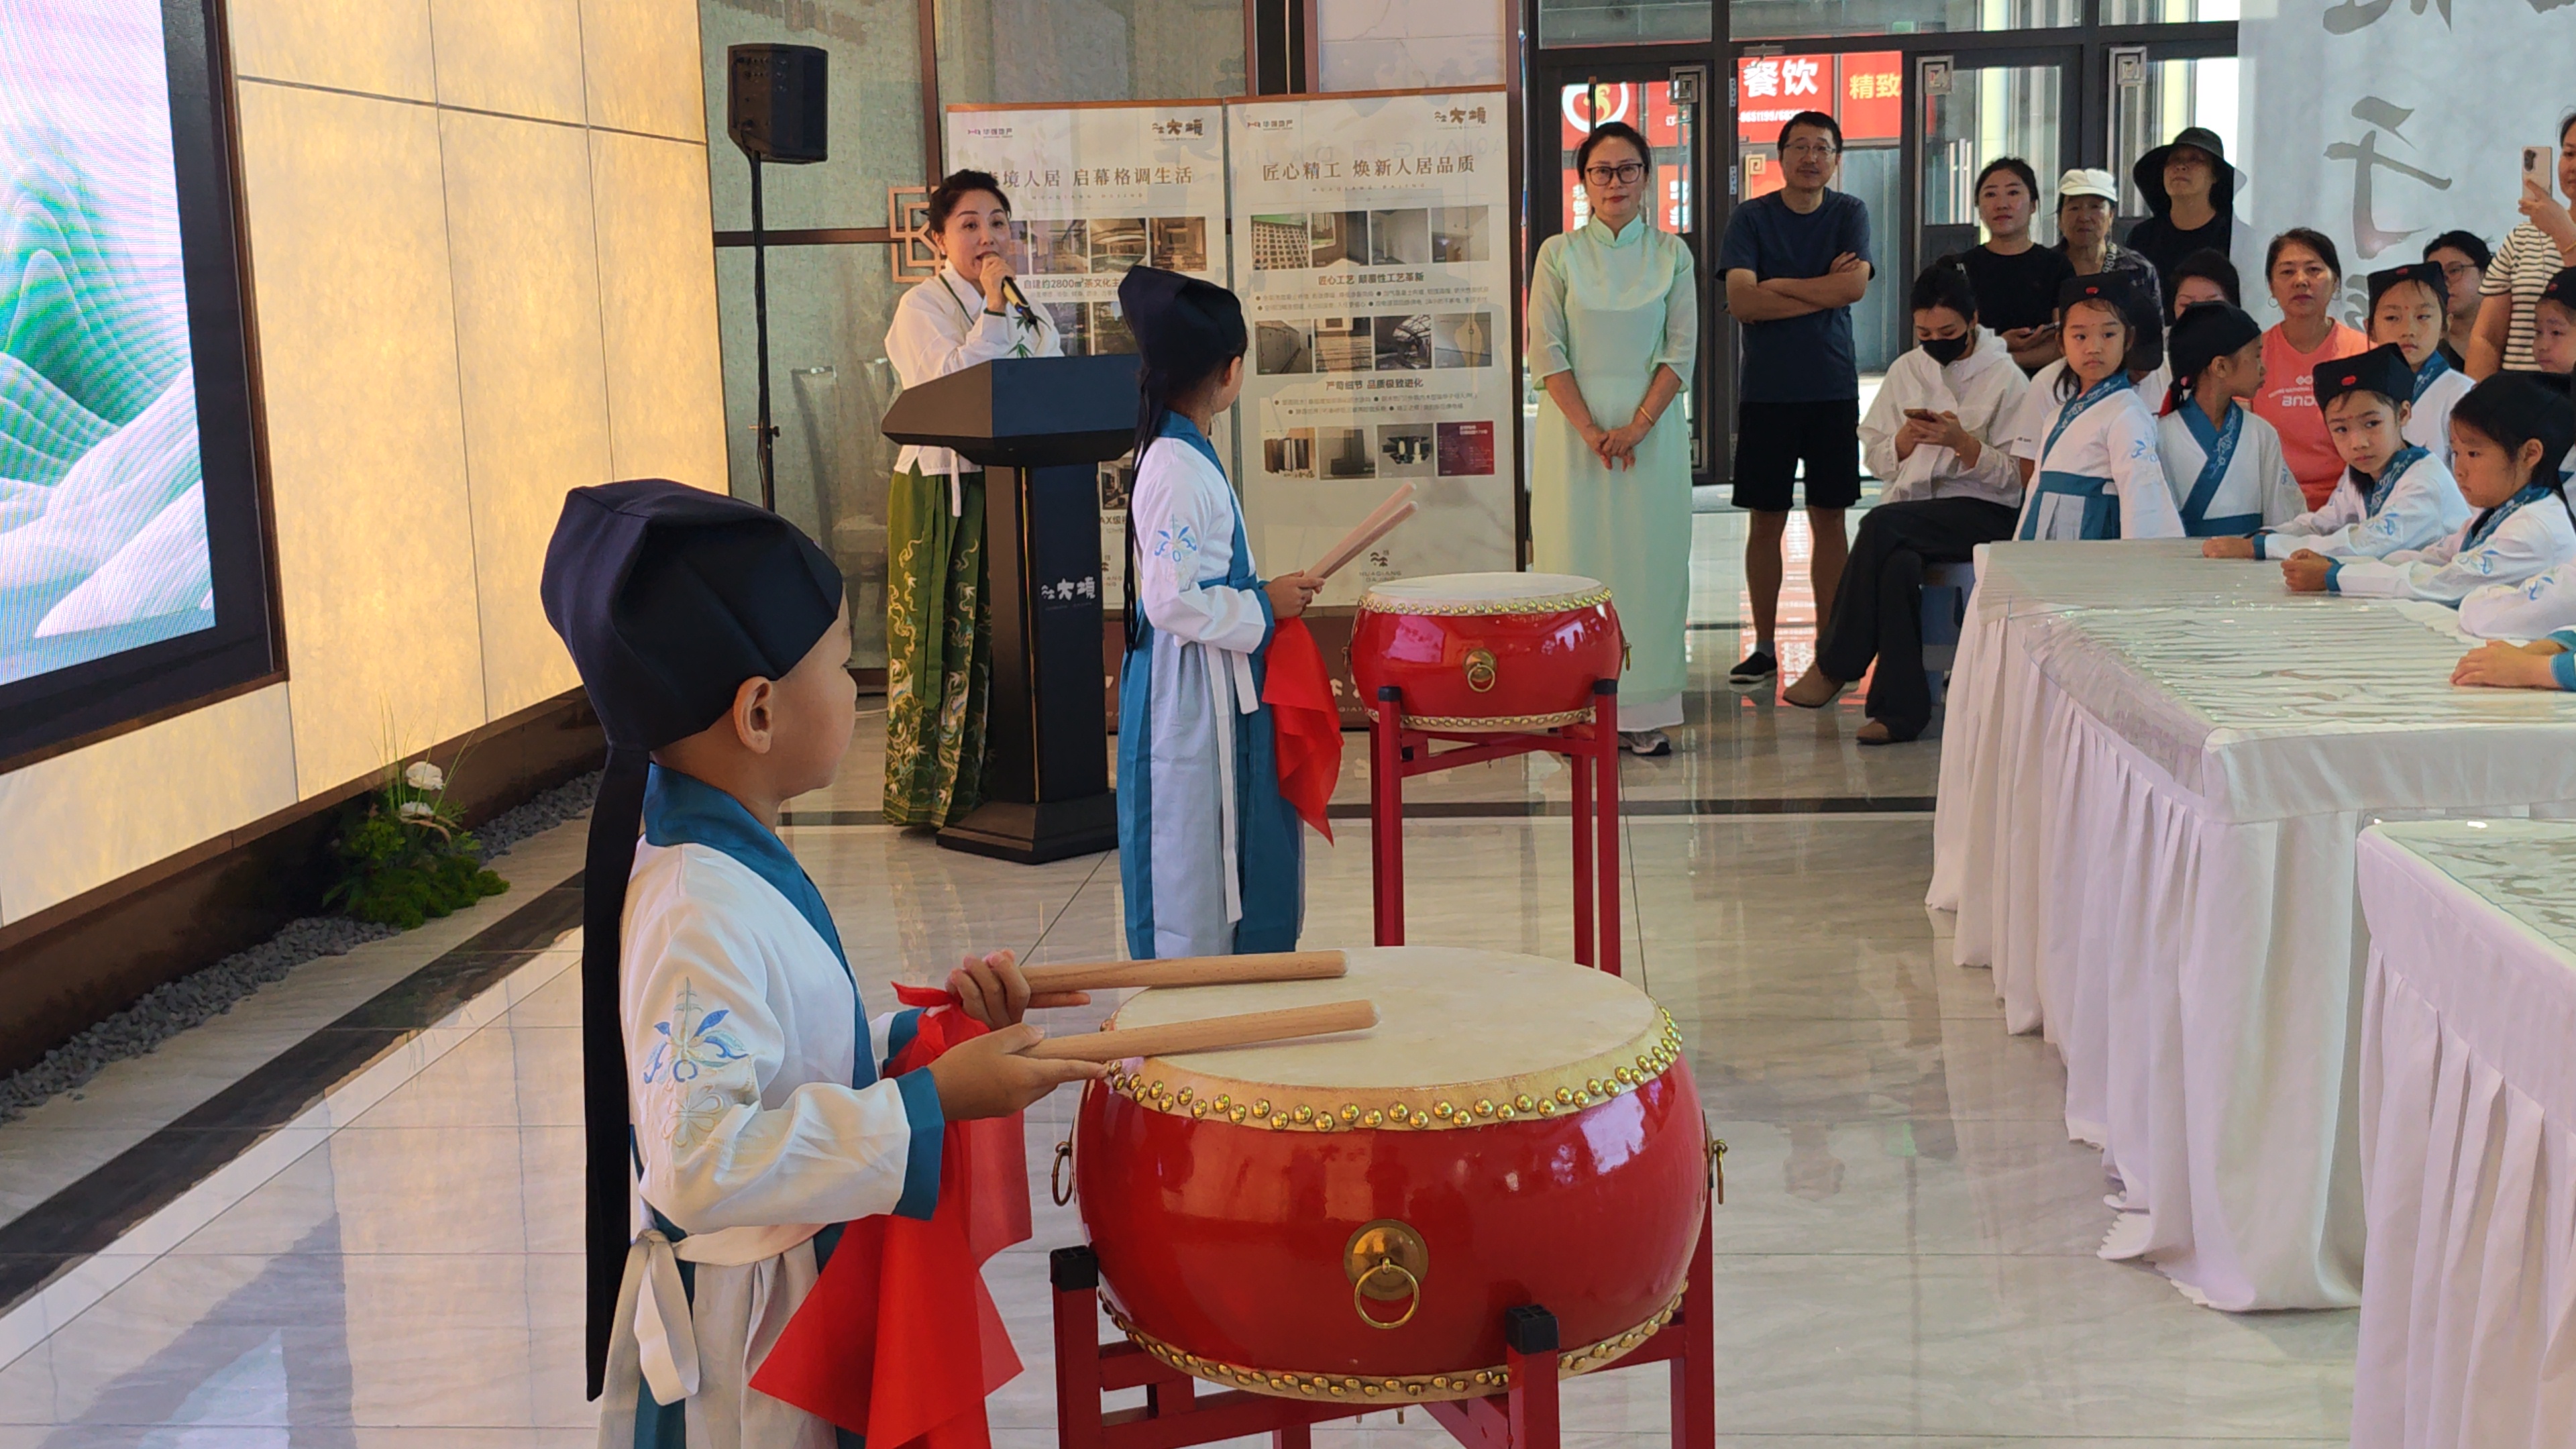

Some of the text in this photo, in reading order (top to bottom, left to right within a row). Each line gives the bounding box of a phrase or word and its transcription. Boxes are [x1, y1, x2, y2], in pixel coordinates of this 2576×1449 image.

[1743, 58, 1819, 97] 餐饮
[1849, 72, 1902, 100] 精致
[989, 166, 1192, 189] 境人居 启幕格调生活
[1263, 155, 1475, 181] 匠心精工 焕新人居品质
[2282, 395, 2318, 407] and
